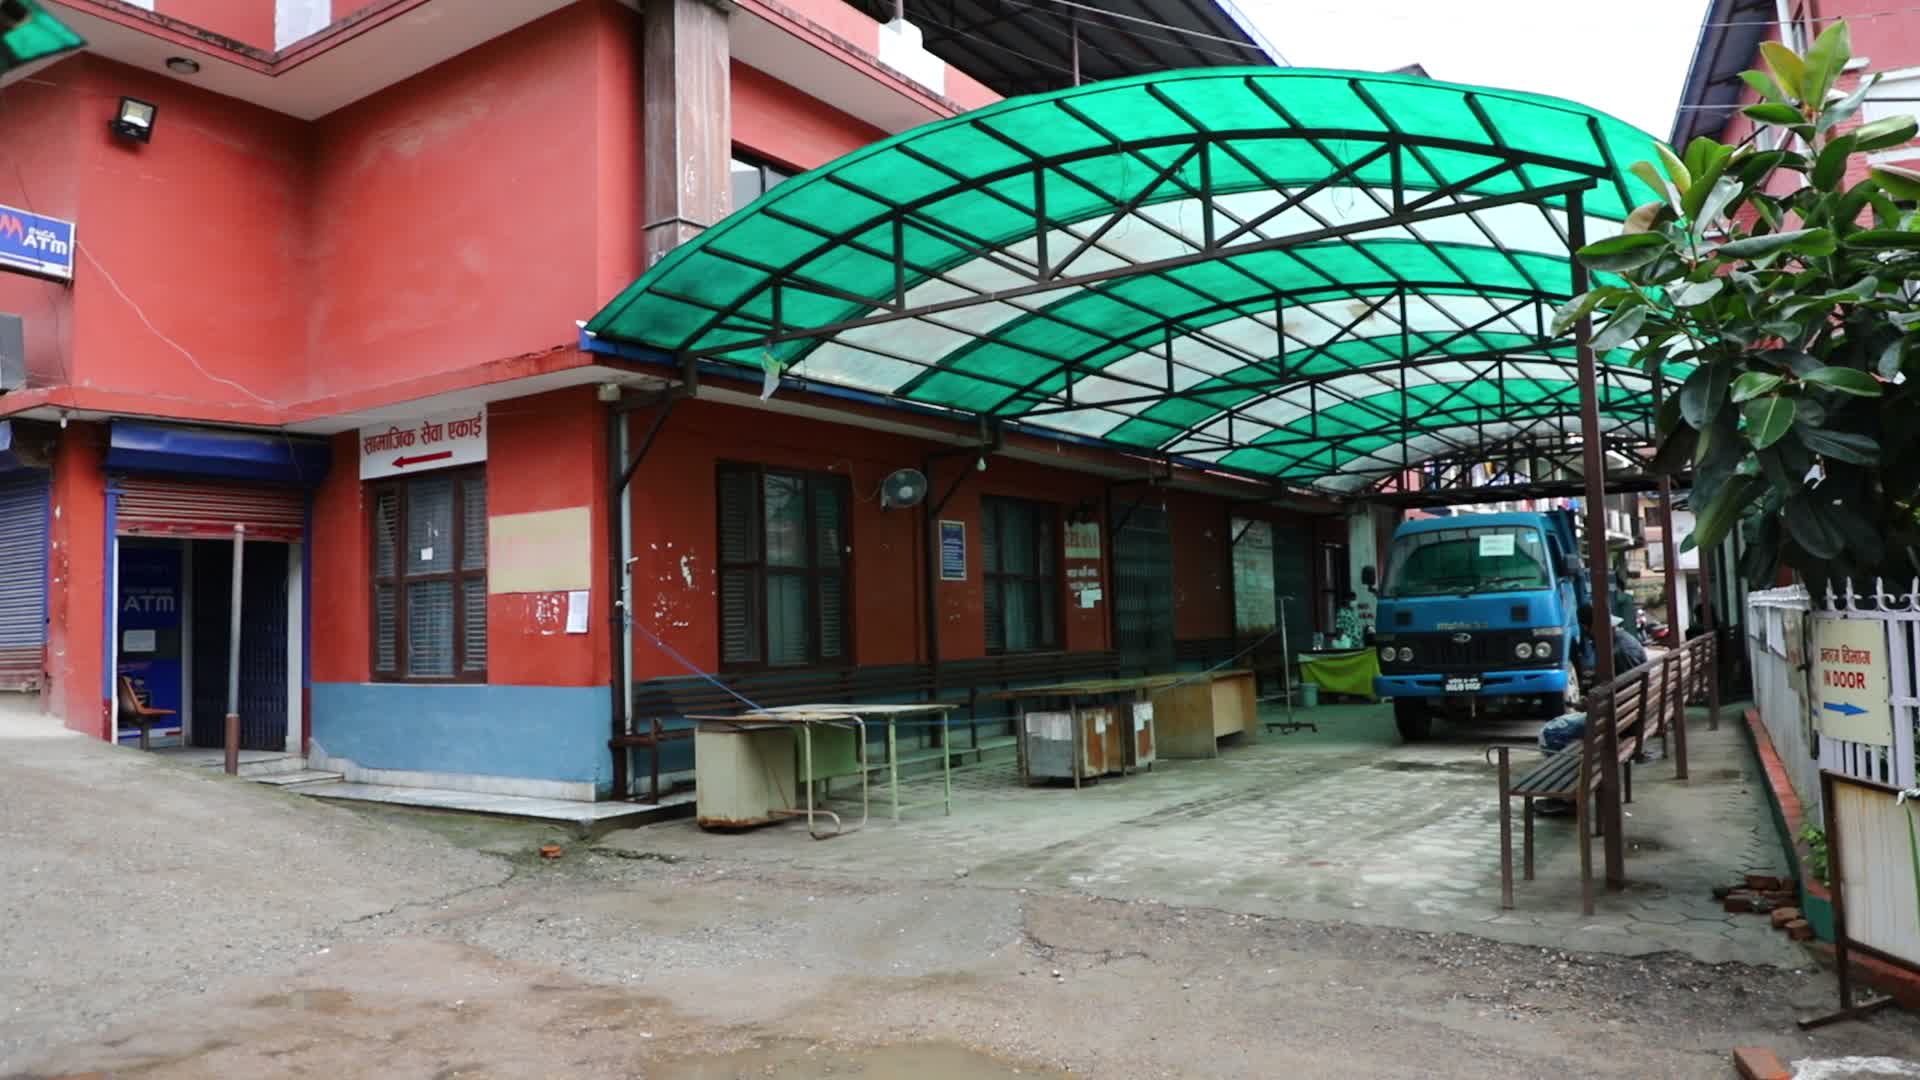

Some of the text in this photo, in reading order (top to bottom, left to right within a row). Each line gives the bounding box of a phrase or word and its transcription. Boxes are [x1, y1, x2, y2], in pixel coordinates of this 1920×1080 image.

[364, 426, 416, 455] सामाजिक
[421, 421, 443, 445] सेवा
[1833, 670, 1866, 689] DOOR
